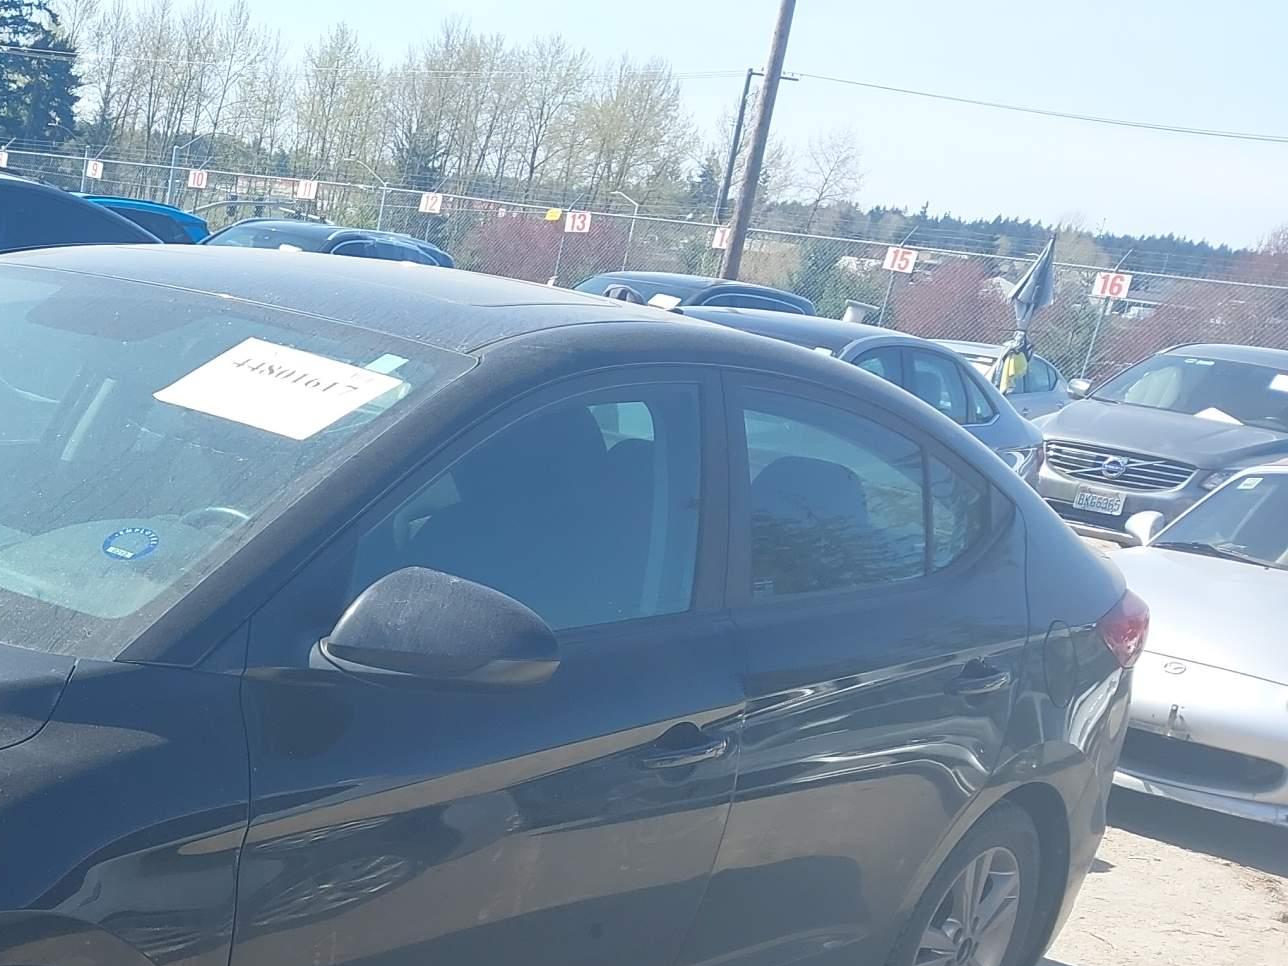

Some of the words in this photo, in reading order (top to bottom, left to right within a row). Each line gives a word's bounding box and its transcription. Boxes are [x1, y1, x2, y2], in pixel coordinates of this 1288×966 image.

[92, 162, 99, 176] 9
[192, 171, 204, 186] 10
[300, 181, 313, 196] 11
[424, 194, 439, 212] 12
[569, 213, 587, 231] 13
[889, 249, 913, 270] 15
[1100, 274, 1125, 296] 16
[232, 358, 359, 396] 44801617
